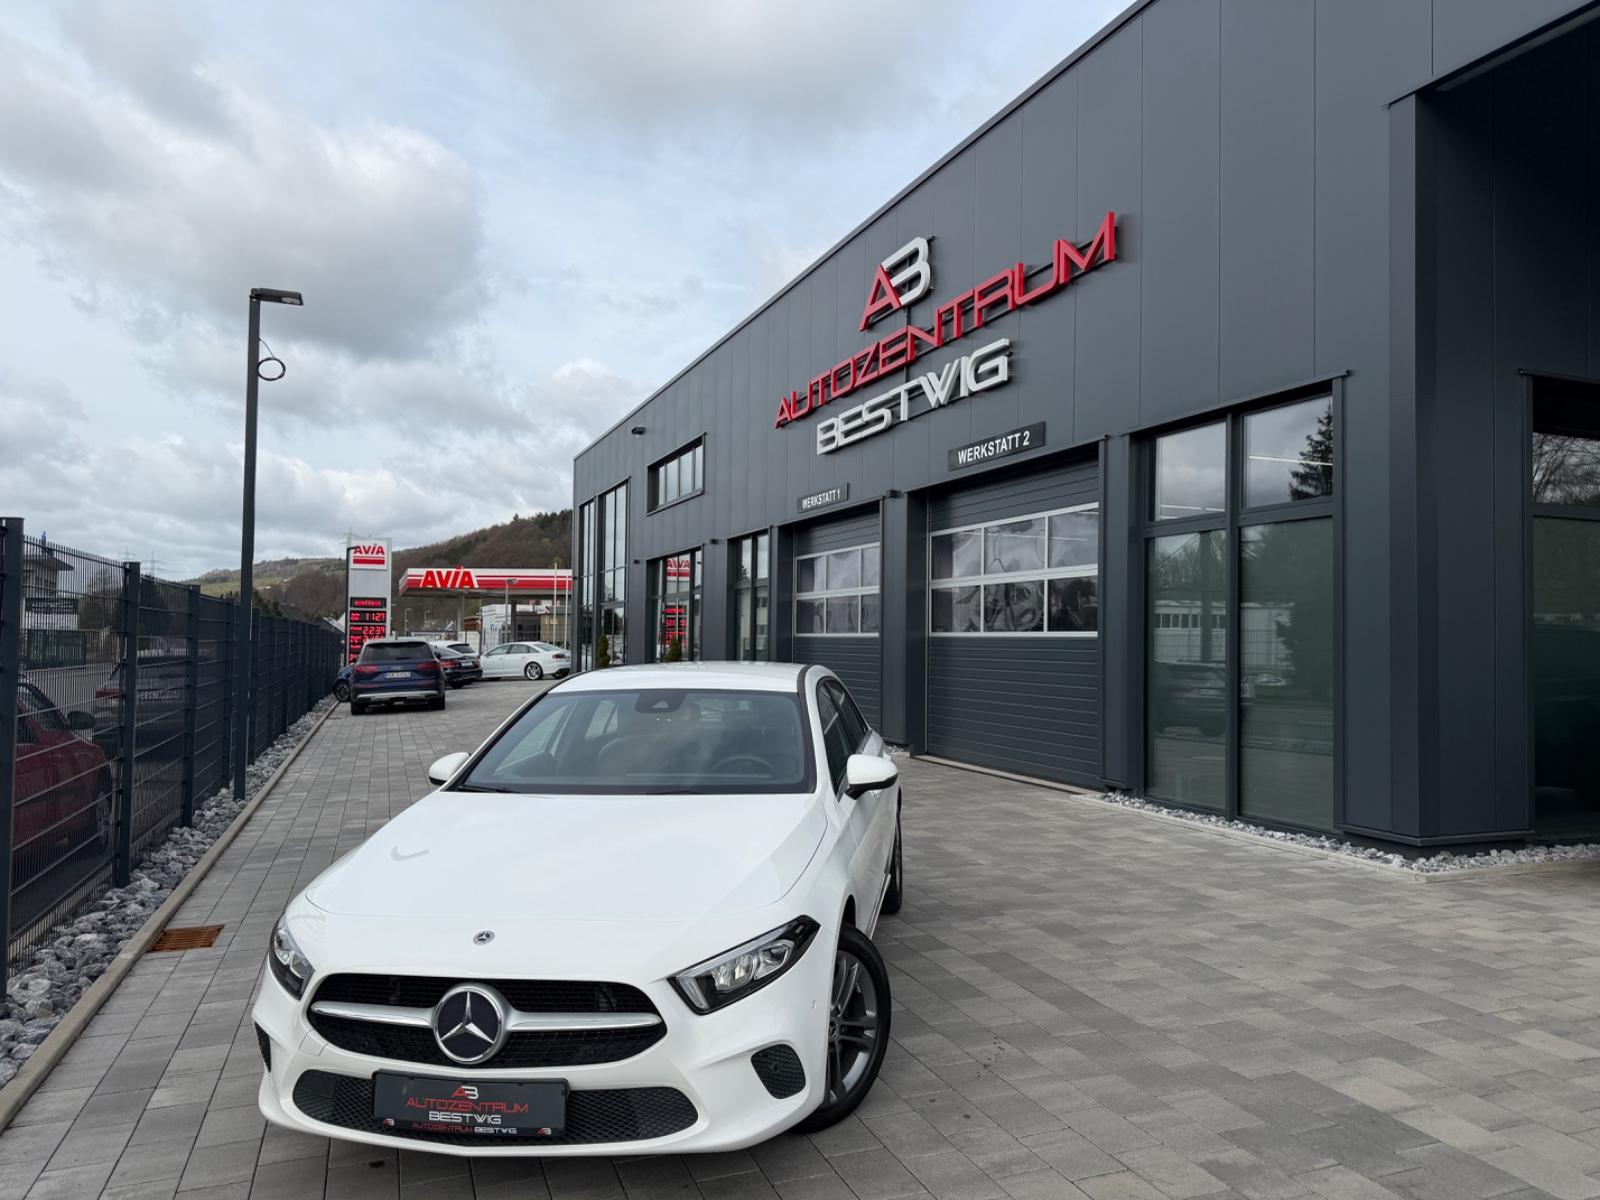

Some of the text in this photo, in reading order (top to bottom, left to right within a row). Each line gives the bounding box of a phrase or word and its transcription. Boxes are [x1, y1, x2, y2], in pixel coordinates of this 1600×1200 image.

[774, 211, 1117, 429] AUTOZENTRUM
[816, 337, 1010, 455] BESTWIG
[958, 430, 1030, 464] WERKSTATT 2
[802, 491, 837, 509] WERKSTATT
[353, 543, 385, 555] AVIA
[421, 566, 476, 588] AVIA
[406, 1097, 528, 1113] AUTOZENTRUM
[428, 1111, 502, 1125] BESTWIG
[412, 1123, 518, 1135] AUTOZENTRUM BESTWIG
